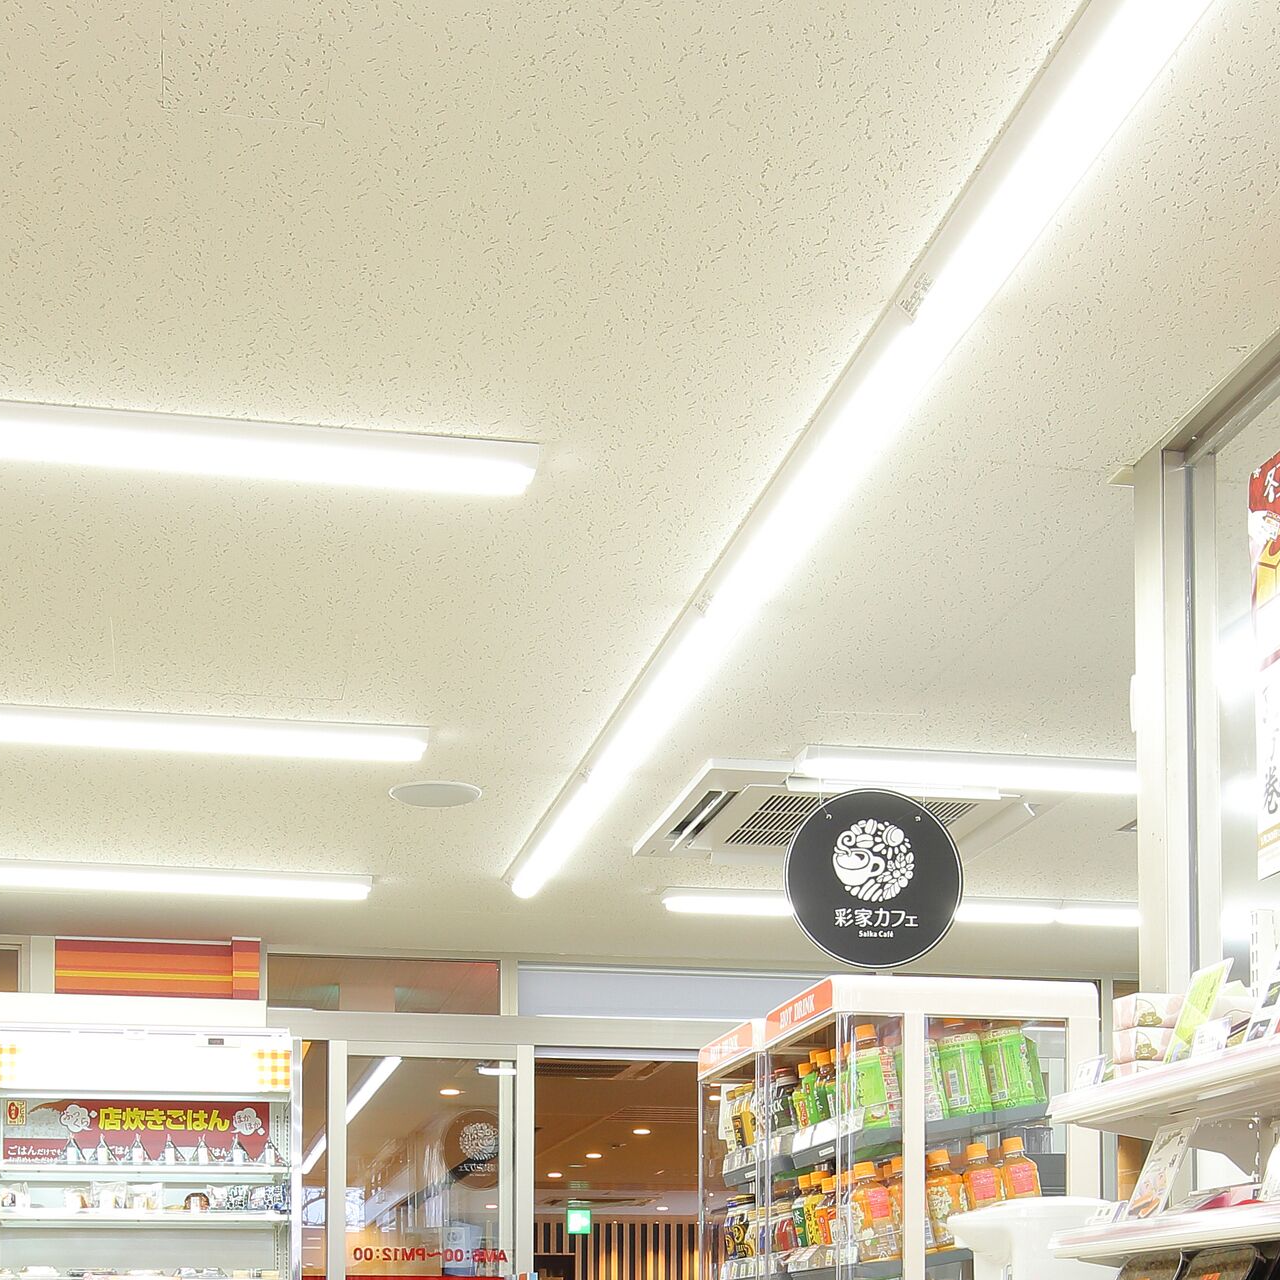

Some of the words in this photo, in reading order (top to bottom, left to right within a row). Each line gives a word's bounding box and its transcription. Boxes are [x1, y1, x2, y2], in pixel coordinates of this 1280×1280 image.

[834, 908, 919, 928] 彩家カフェ
[793, 993, 816, 1022] DRINK
[99, 1107, 231, 1131] 店炊きごはん
